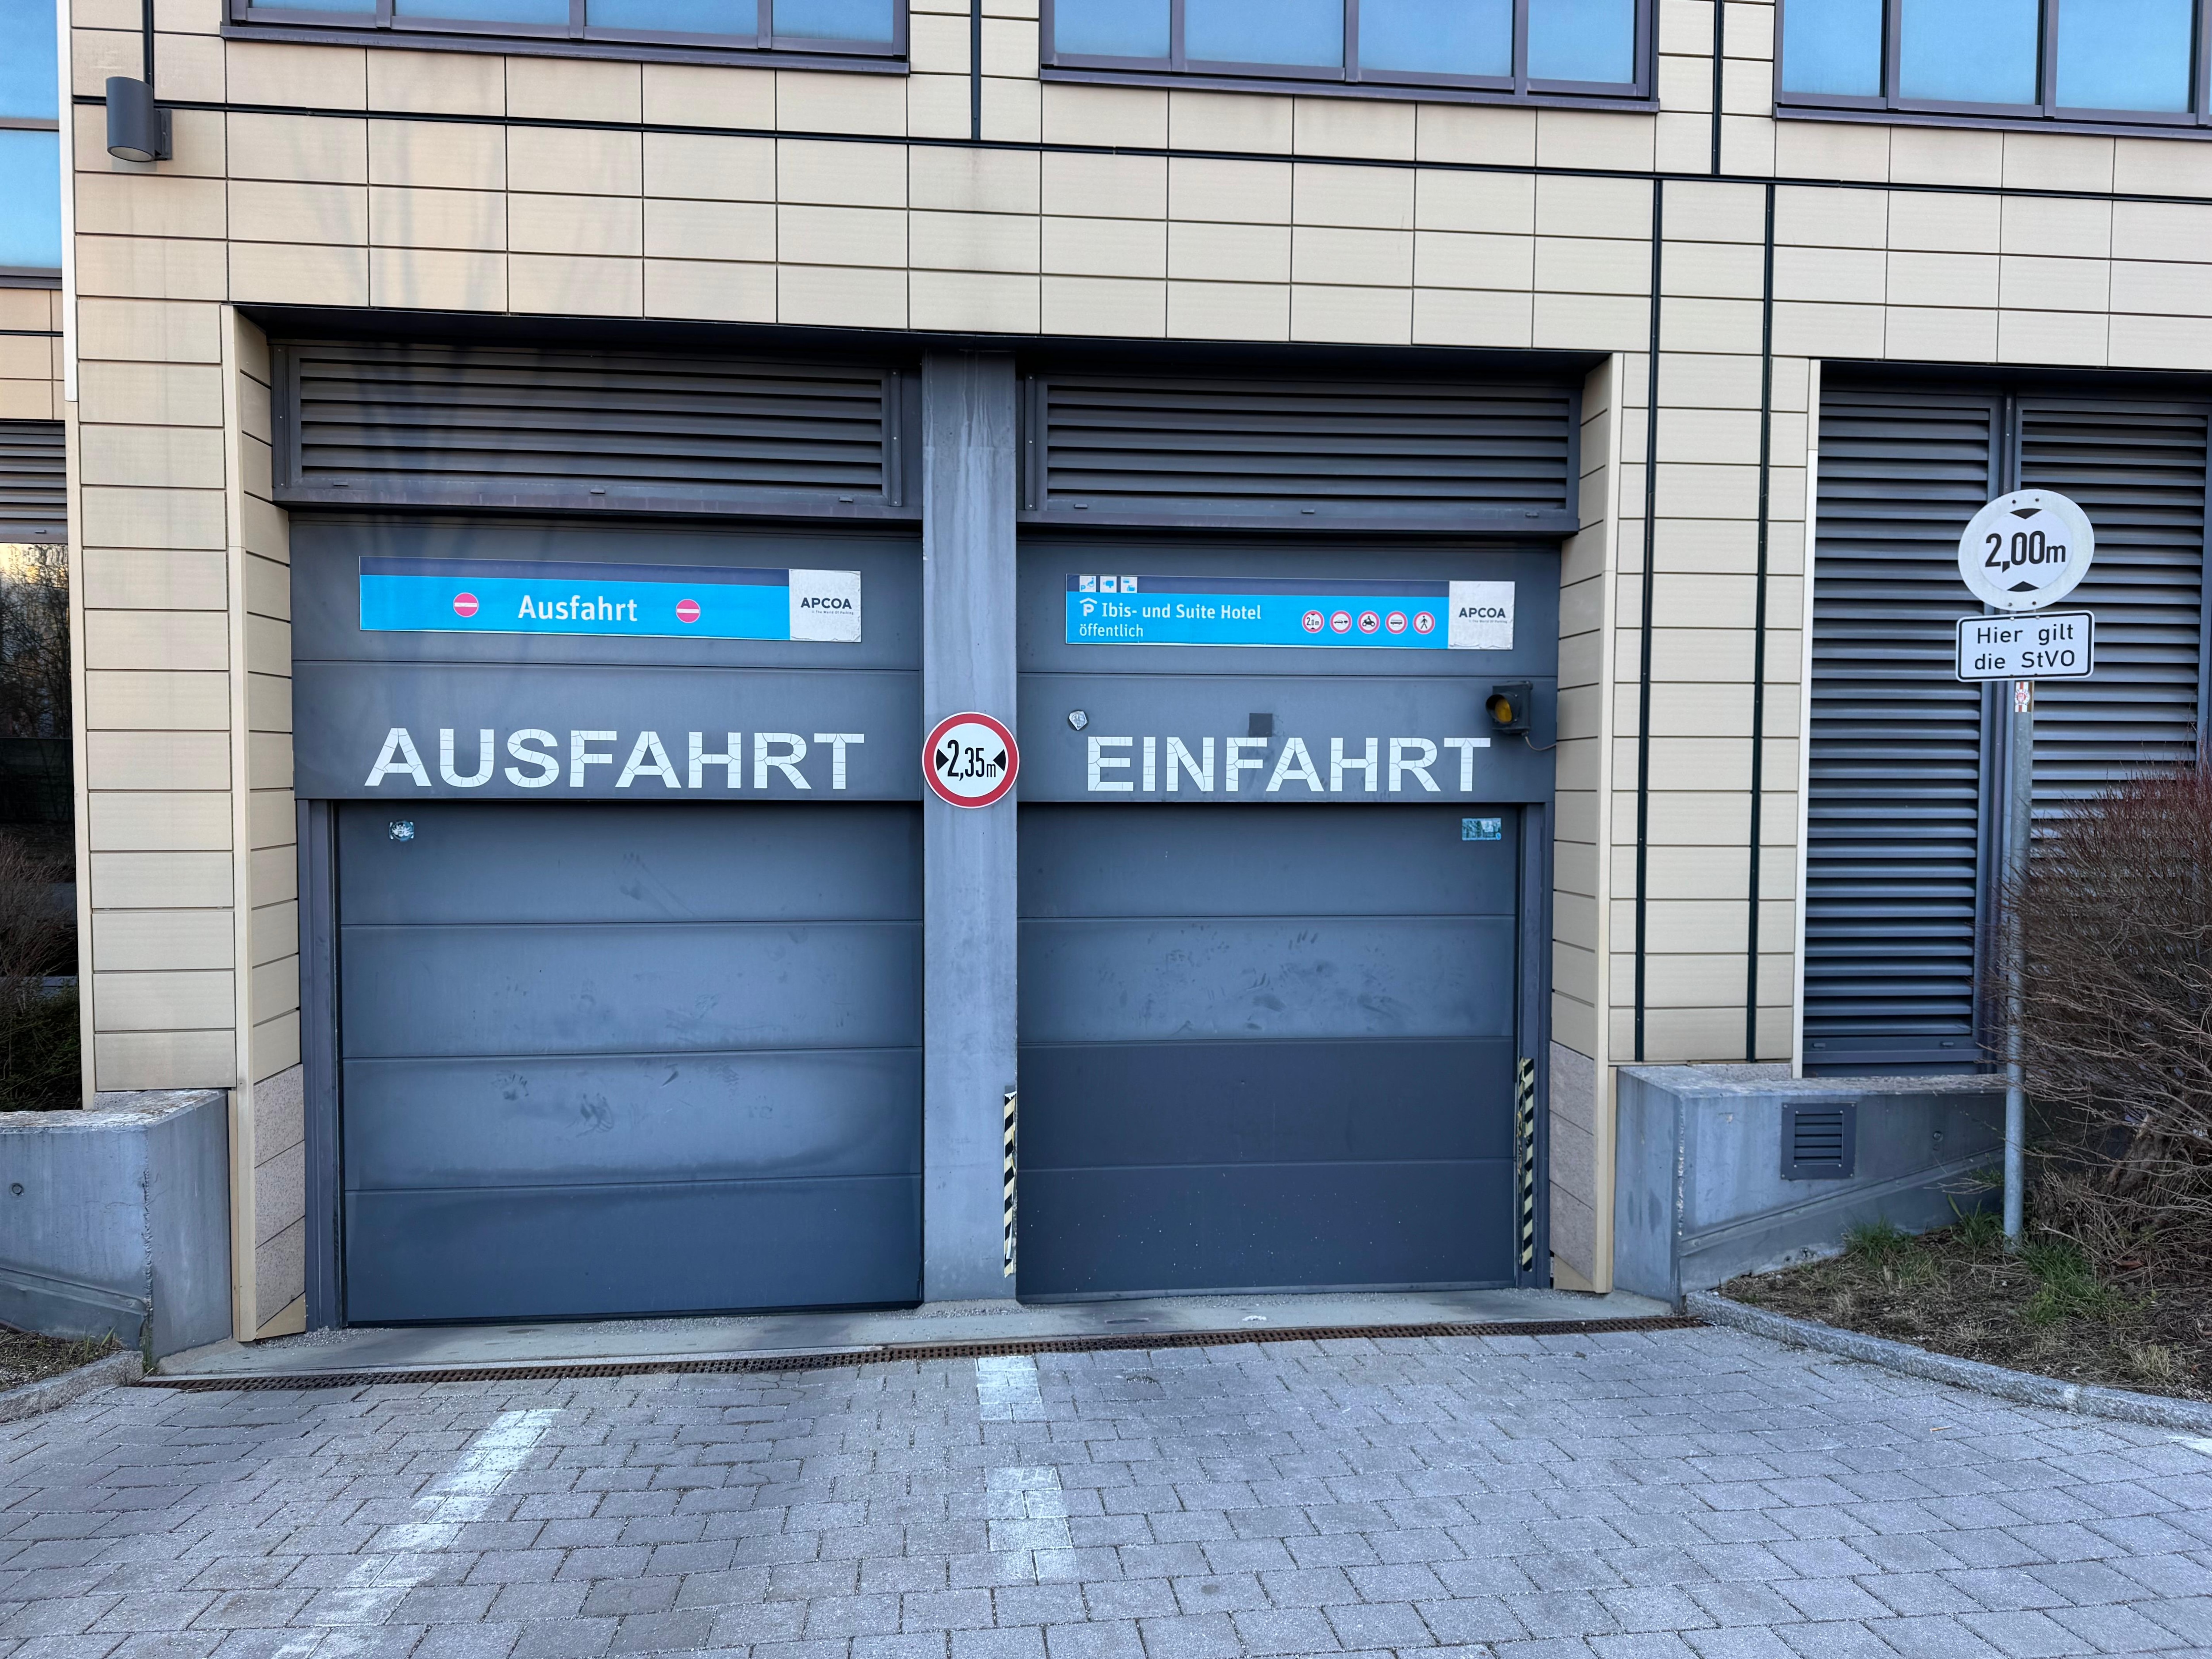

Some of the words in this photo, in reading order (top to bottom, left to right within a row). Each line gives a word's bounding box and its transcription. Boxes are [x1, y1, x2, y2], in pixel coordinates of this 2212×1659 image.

[1985, 530, 2066, 572] 2,00m
[518, 595, 637, 621] Ausfahrt
[801, 597, 852, 609] APCOA
[1102, 602, 1137, 617] Ibis-
[1142, 603, 1170, 618] und
[1176, 604, 1216, 619] Suite
[1221, 605, 1261, 619] Hotel
[1459, 607, 1505, 618] APCOA
[1079, 623, 1143, 637] öffentlich
[1978, 627, 2023, 644] Hier
[2038, 623, 2074, 645] gilt
[1975, 653, 2005, 670] die
[2021, 650, 2075, 668] StVO
[364, 728, 864, 789] AUSFAHRT
[948, 740, 996, 781] 2,35m
[1087, 736, 1491, 791] EINFAHRT
